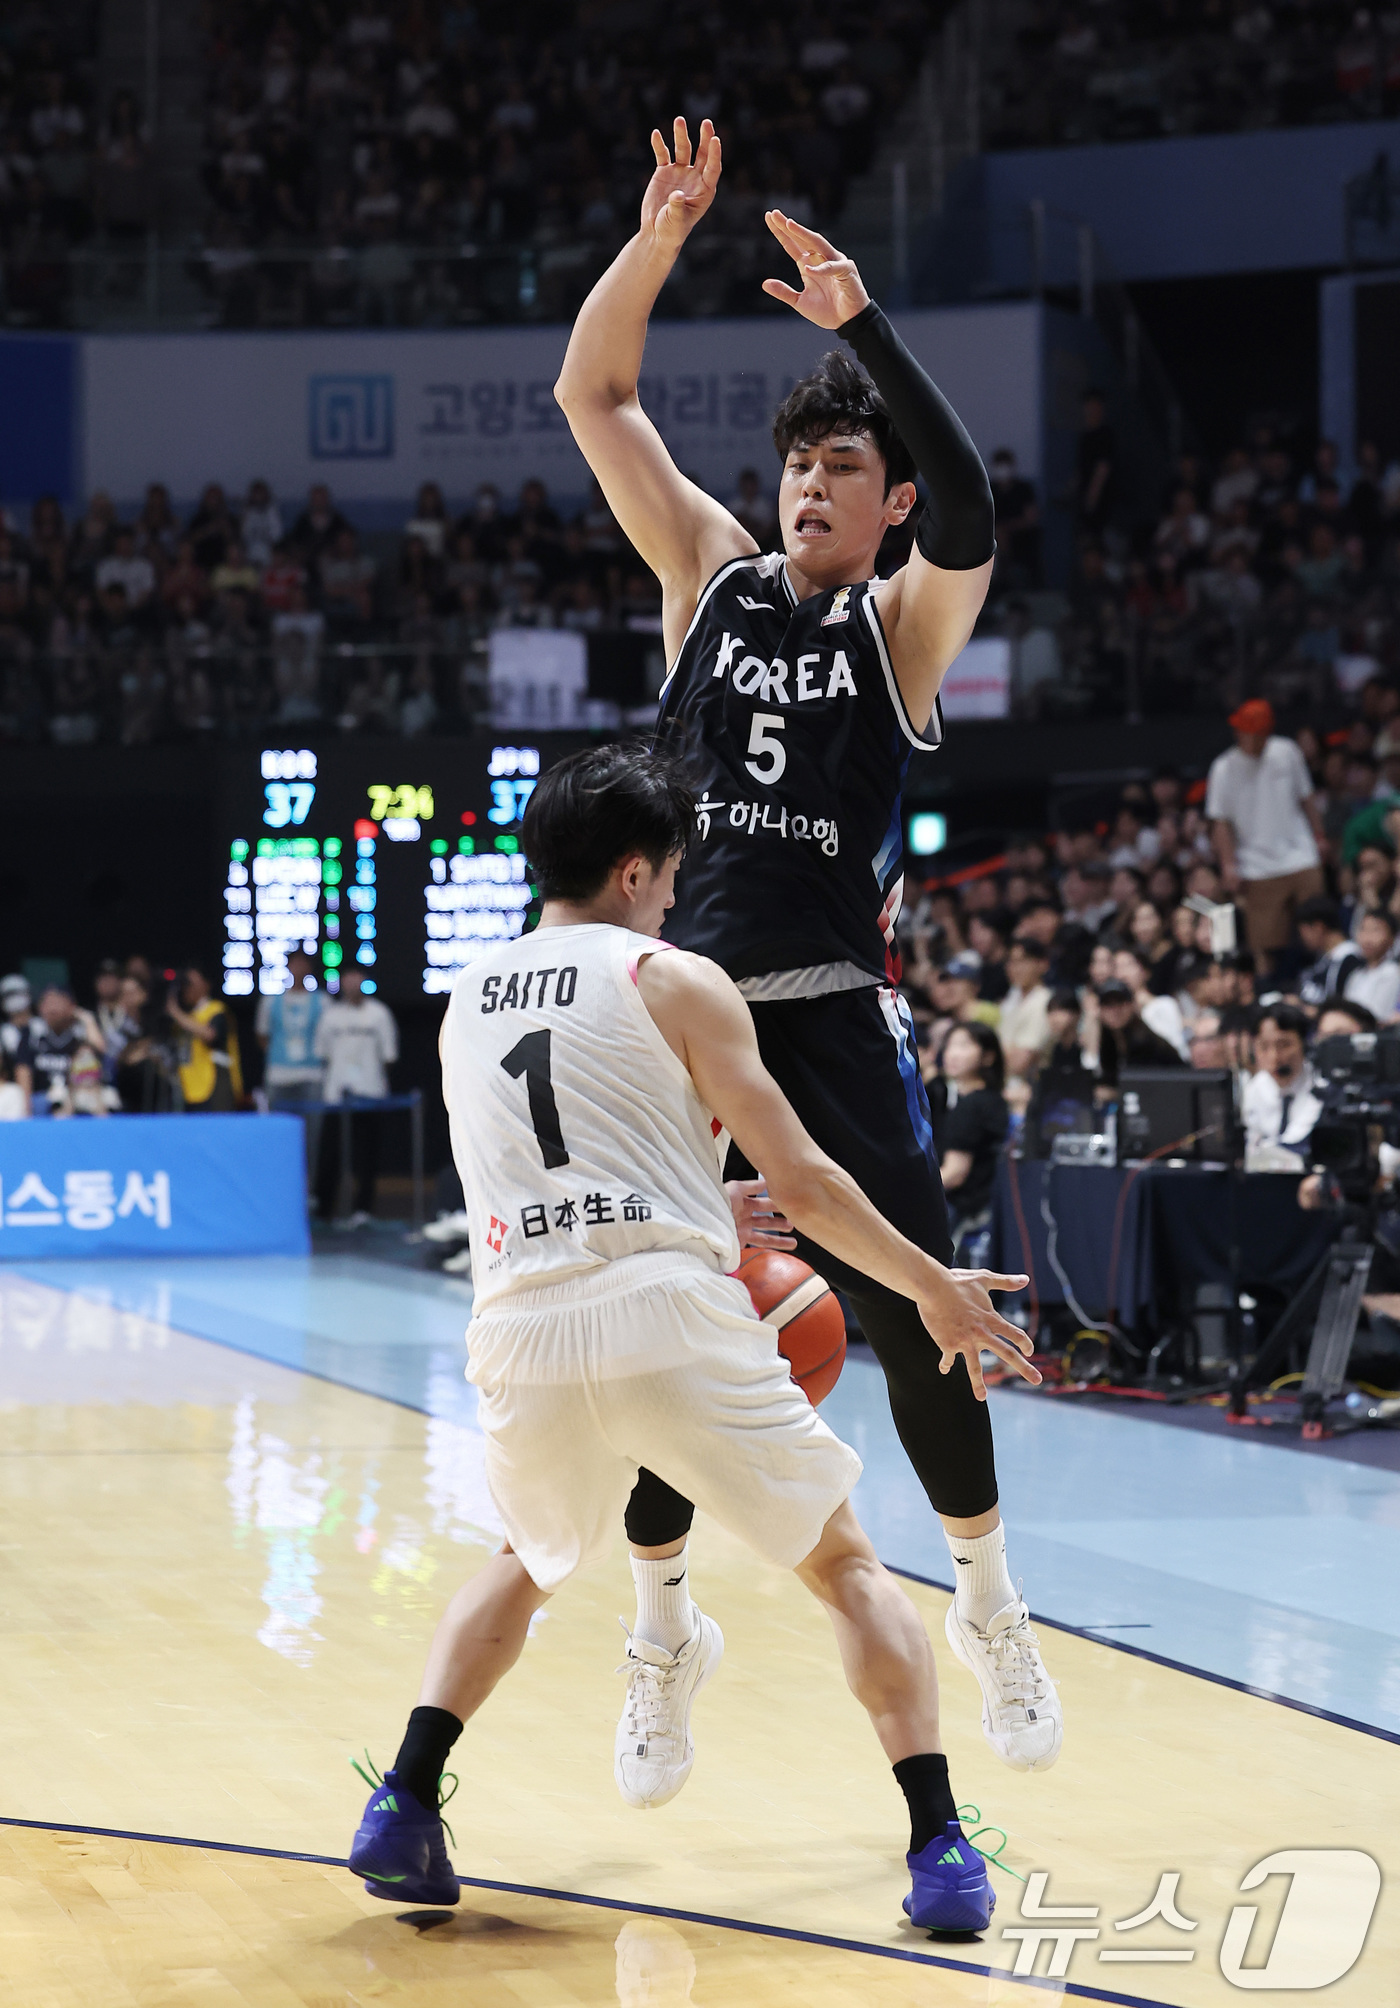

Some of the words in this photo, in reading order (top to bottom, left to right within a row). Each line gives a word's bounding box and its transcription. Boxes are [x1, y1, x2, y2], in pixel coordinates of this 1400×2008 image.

[712, 631, 859, 704] KOREA
[744, 712, 787, 786] 5
[263, 782, 316, 827] 37
[488, 780, 537, 825] 37
[481, 966, 578, 1015] SAITO
[501, 1028, 570, 1170] 1
[0, 1169, 172, 1231] 스동서
[520, 1192, 653, 1239] 日本生命
[488, 1250, 513, 1273] NISY
